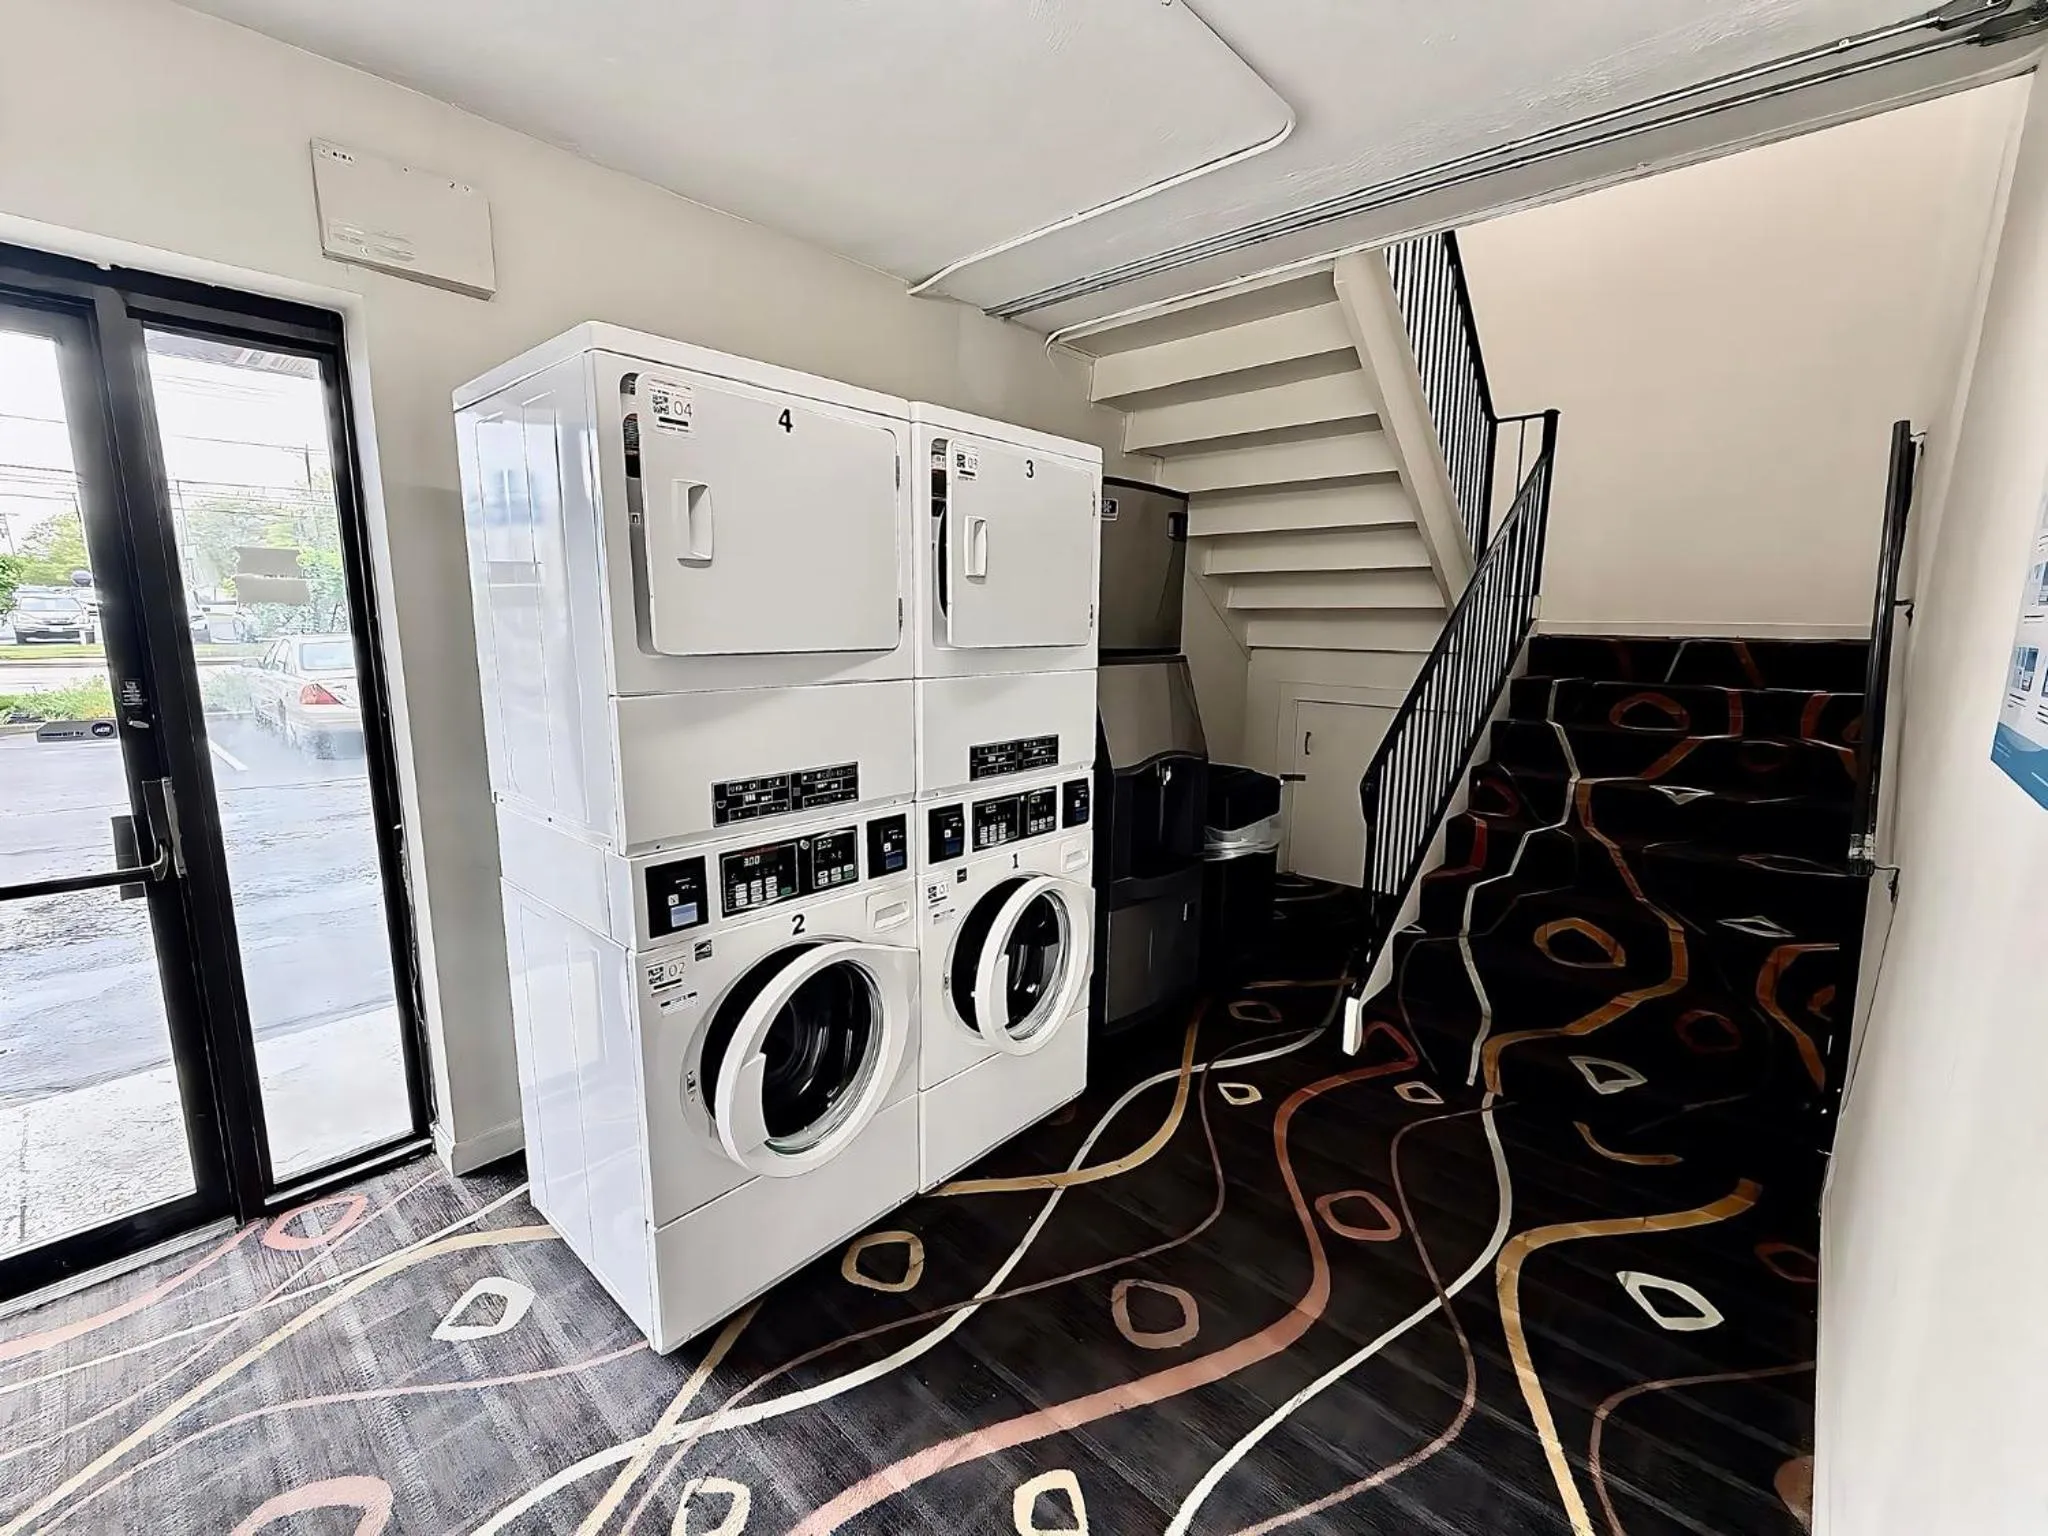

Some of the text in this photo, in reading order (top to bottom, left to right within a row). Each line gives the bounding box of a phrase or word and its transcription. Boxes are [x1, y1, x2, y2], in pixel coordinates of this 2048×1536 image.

[777, 407, 794, 433] 4
[1025, 459, 1035, 479] 3
[1012, 853, 1020, 869] 1
[791, 913, 806, 936] 2
